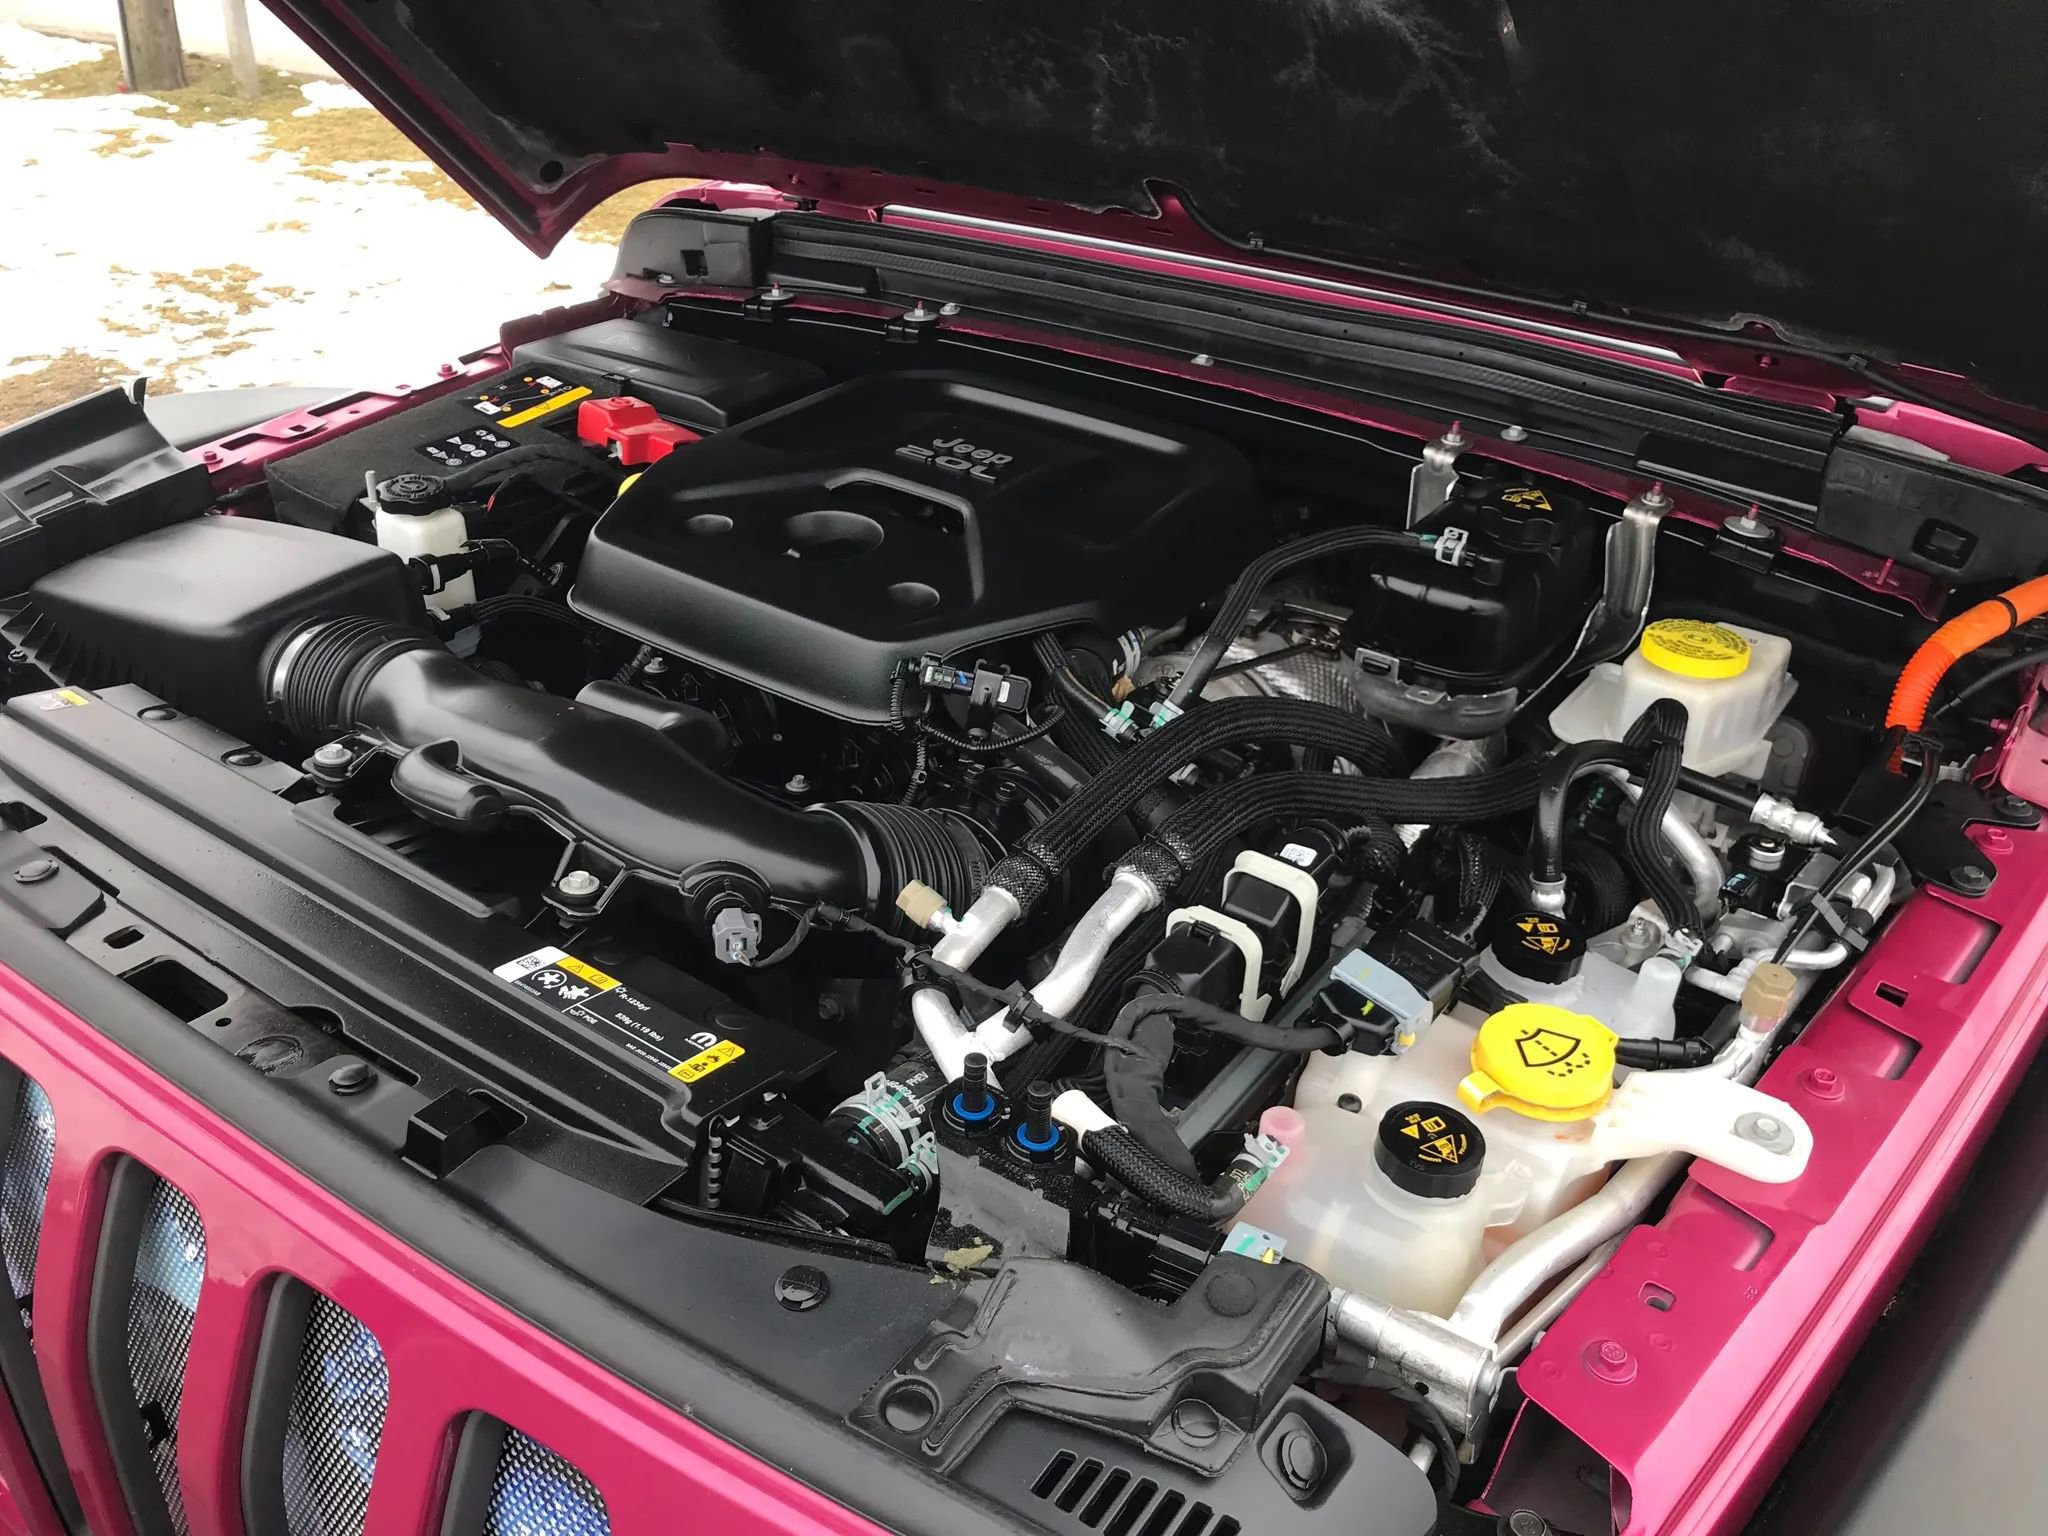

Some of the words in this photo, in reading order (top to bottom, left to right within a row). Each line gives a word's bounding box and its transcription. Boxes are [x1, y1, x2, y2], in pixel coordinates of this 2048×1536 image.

[932, 438, 1014, 465] Jeep
[895, 444, 997, 482] 2.0L
[619, 993, 651, 1011] R-1234yf
[905, 1070, 929, 1087] PHEV
